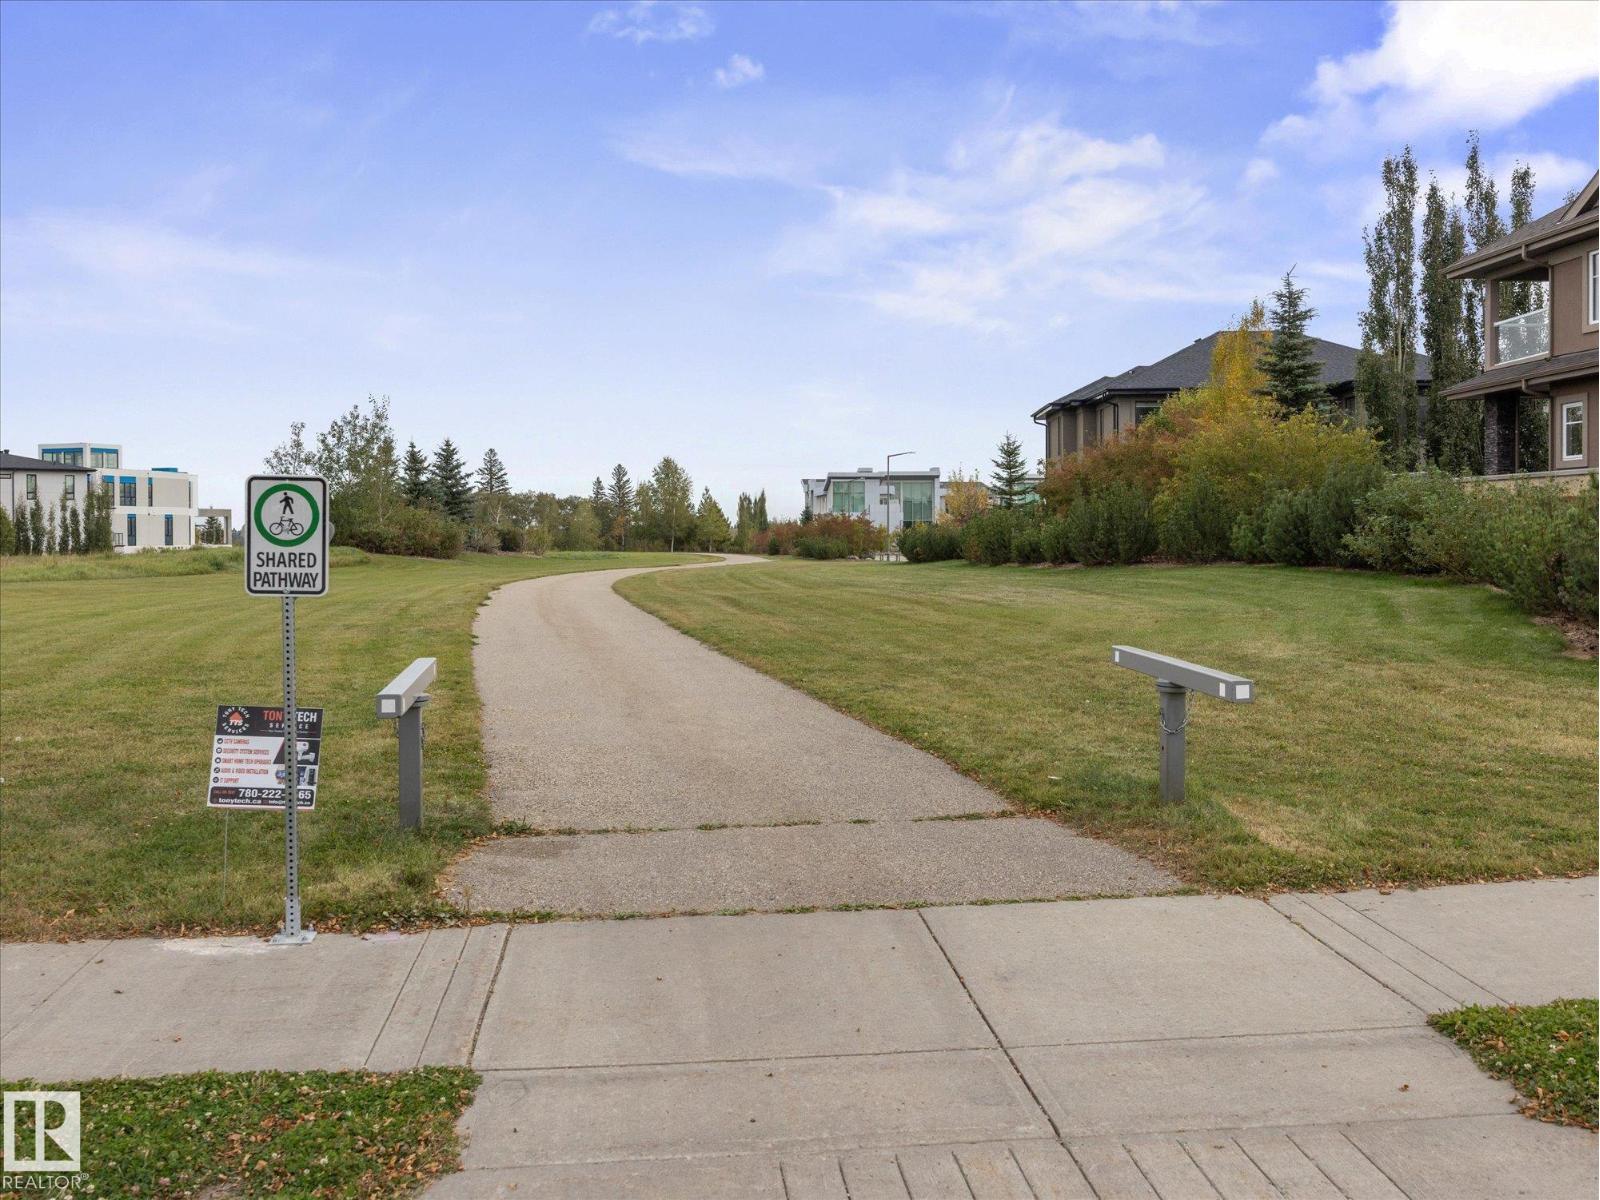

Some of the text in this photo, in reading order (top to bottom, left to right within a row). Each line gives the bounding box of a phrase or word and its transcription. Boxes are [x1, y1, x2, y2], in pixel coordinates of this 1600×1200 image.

[256, 552, 317, 568] SHARED
[253, 572, 319, 588] PATHWAY
[263, 710, 317, 722] TON ECH
[238, 789, 311, 799] 780-222-65
